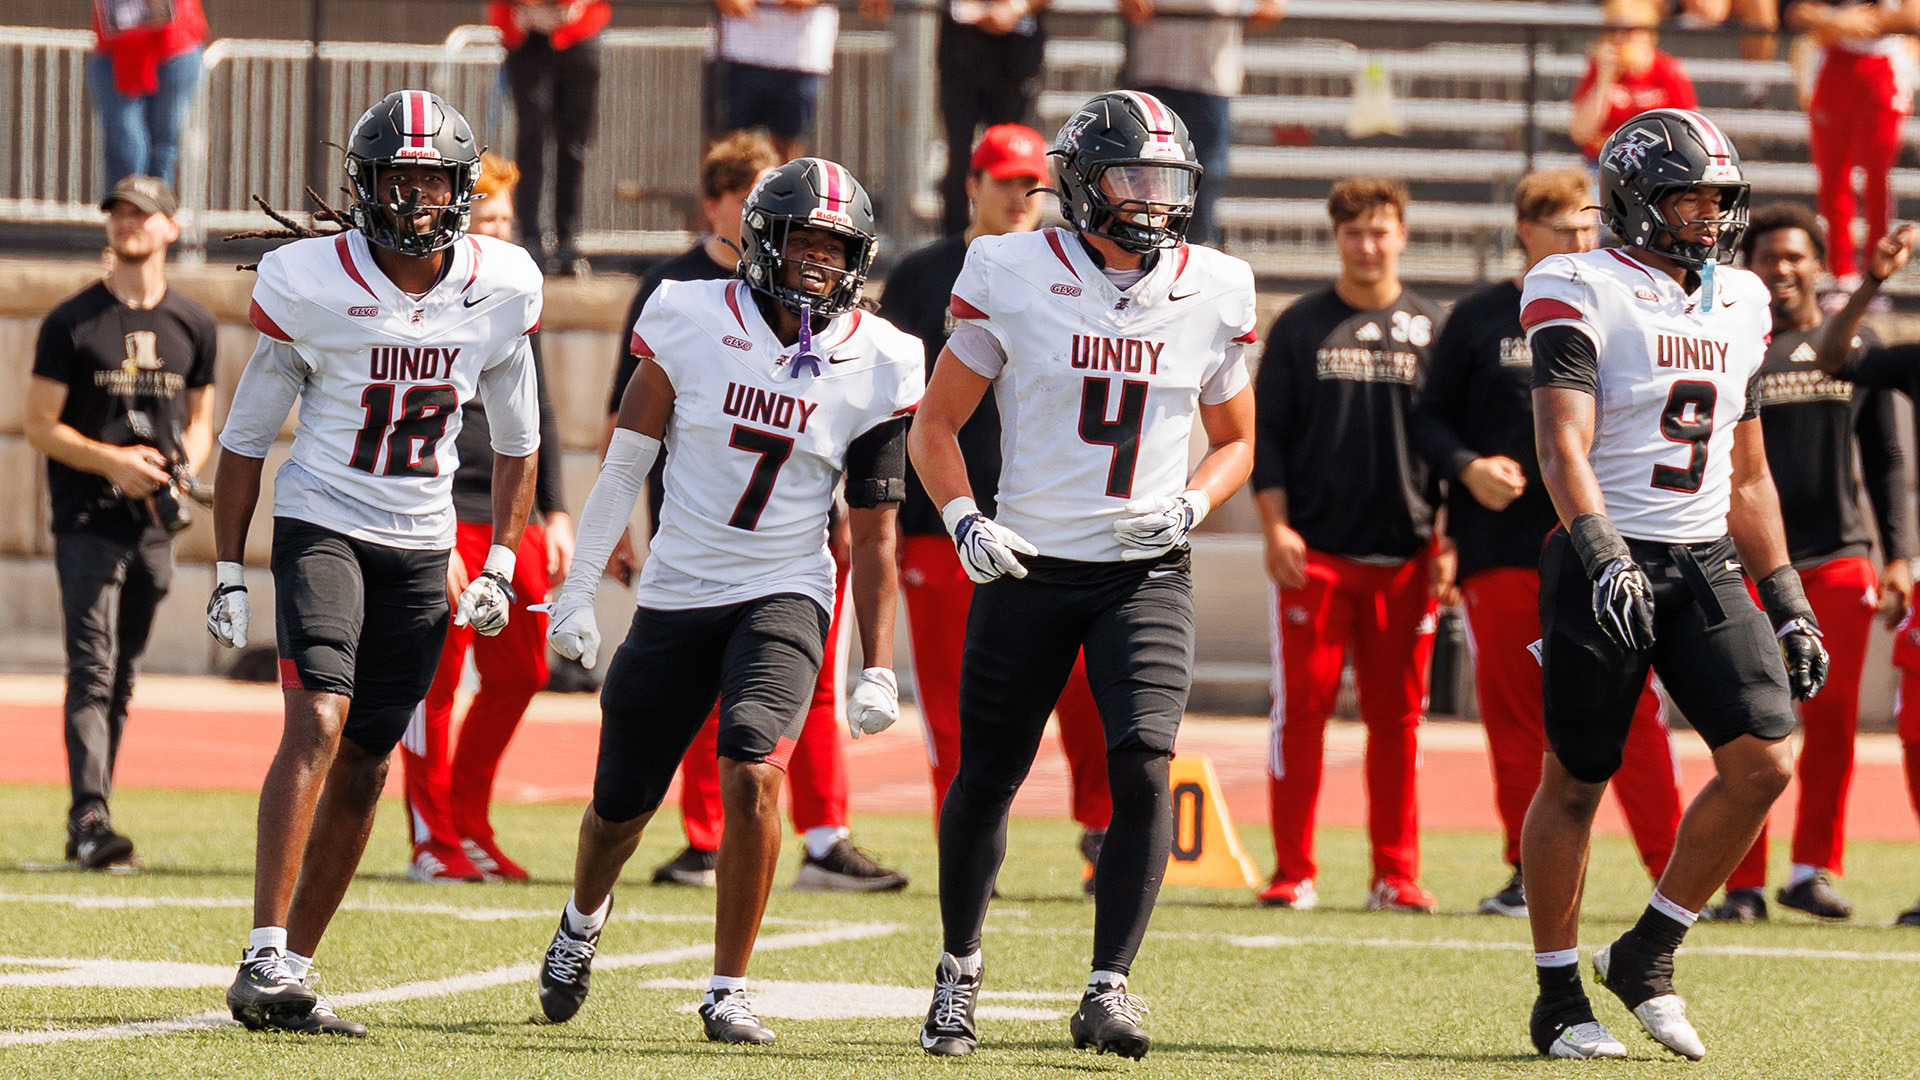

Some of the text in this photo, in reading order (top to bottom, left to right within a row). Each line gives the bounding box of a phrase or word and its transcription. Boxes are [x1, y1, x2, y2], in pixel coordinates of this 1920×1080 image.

[816, 211, 849, 224] Riddell
[1051, 284, 1081, 297] GLVC
[349, 306, 379, 317] GLVC
[1391, 310, 1433, 347] 36
[723, 335, 752, 351] GLVC
[1071, 334, 1165, 375] UINDY
[1657, 334, 1729, 373] UINDY
[370, 347, 461, 380] UINDY
[722, 381, 819, 434] UINDY
[347, 383, 459, 477] 18
[1078, 376, 1148, 499] 4
[1650, 379, 1718, 494] 9
[727, 423, 795, 531] 7
